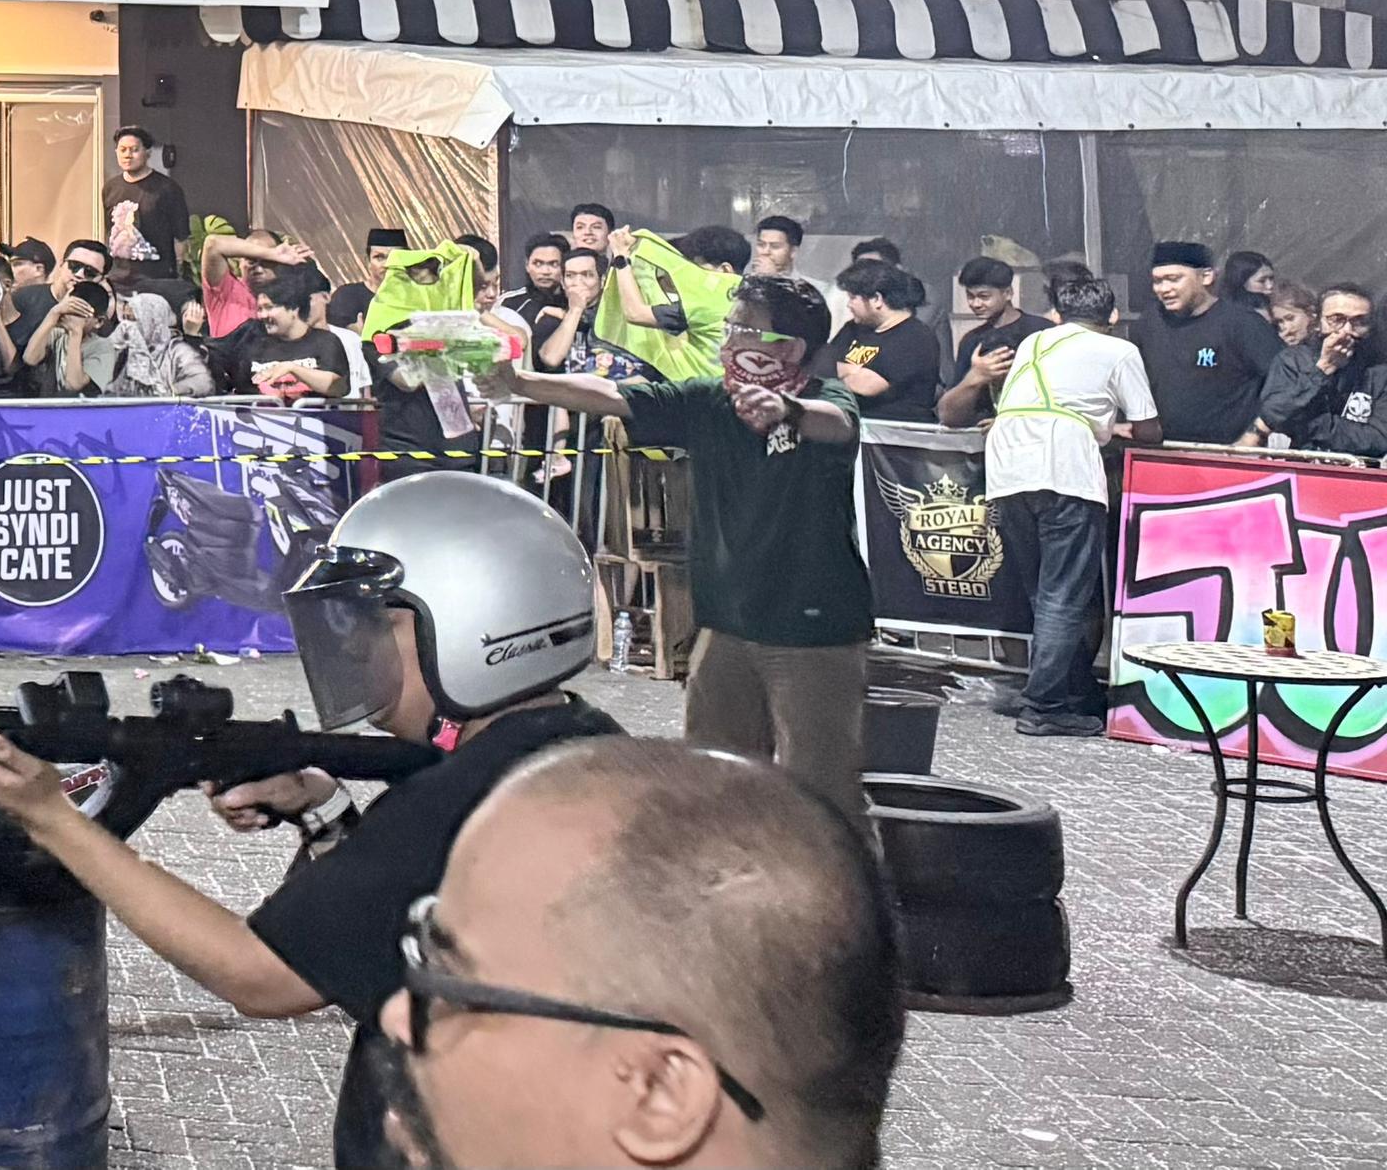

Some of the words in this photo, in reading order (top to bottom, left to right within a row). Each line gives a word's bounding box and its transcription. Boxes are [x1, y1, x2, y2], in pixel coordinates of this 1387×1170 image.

[0, 479, 72, 512] JUST
[916, 508, 979, 528] ROYAL
[915, 533, 986, 553] AGENCY
[0, 547, 72, 580] CATE
[926, 580, 987, 597] STEBO
